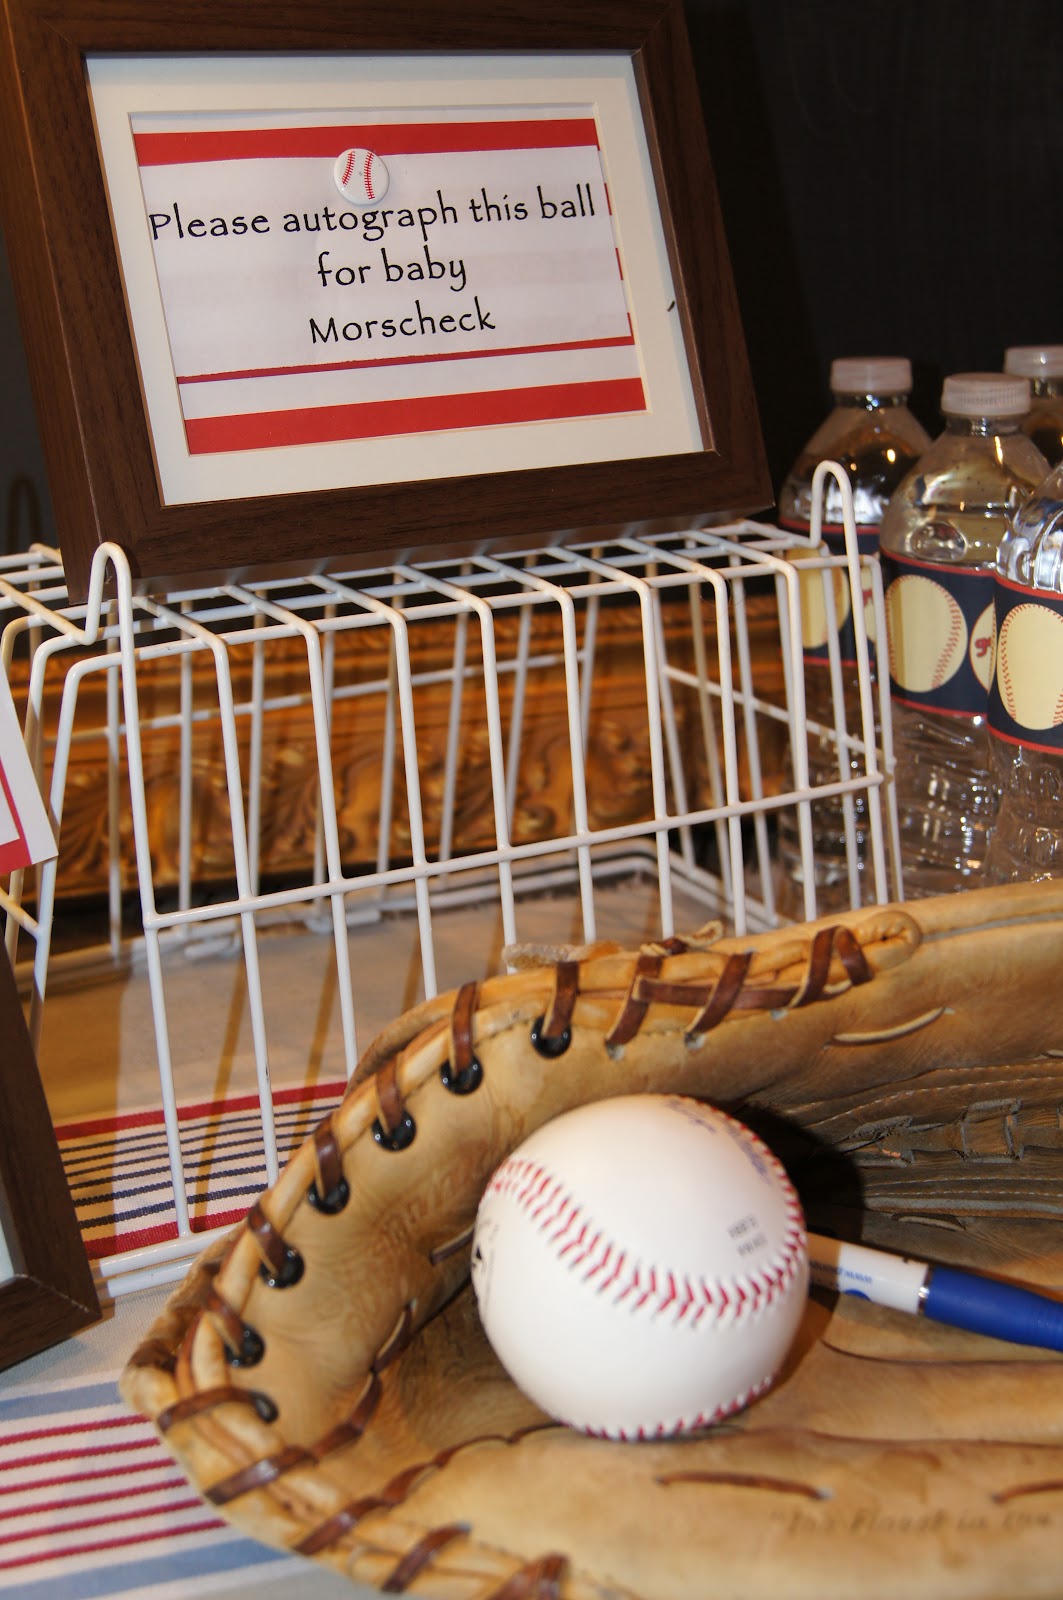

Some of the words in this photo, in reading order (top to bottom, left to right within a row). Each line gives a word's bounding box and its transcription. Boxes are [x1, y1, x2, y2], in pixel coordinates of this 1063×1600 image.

[148, 202, 271, 241] Please
[283, 189, 458, 243] autograph
[468, 187, 529, 223] this
[536, 182, 595, 220] ball
[317, 251, 372, 287] for
[381, 244, 467, 293] baby
[309, 295, 496, 344] Morscheck
